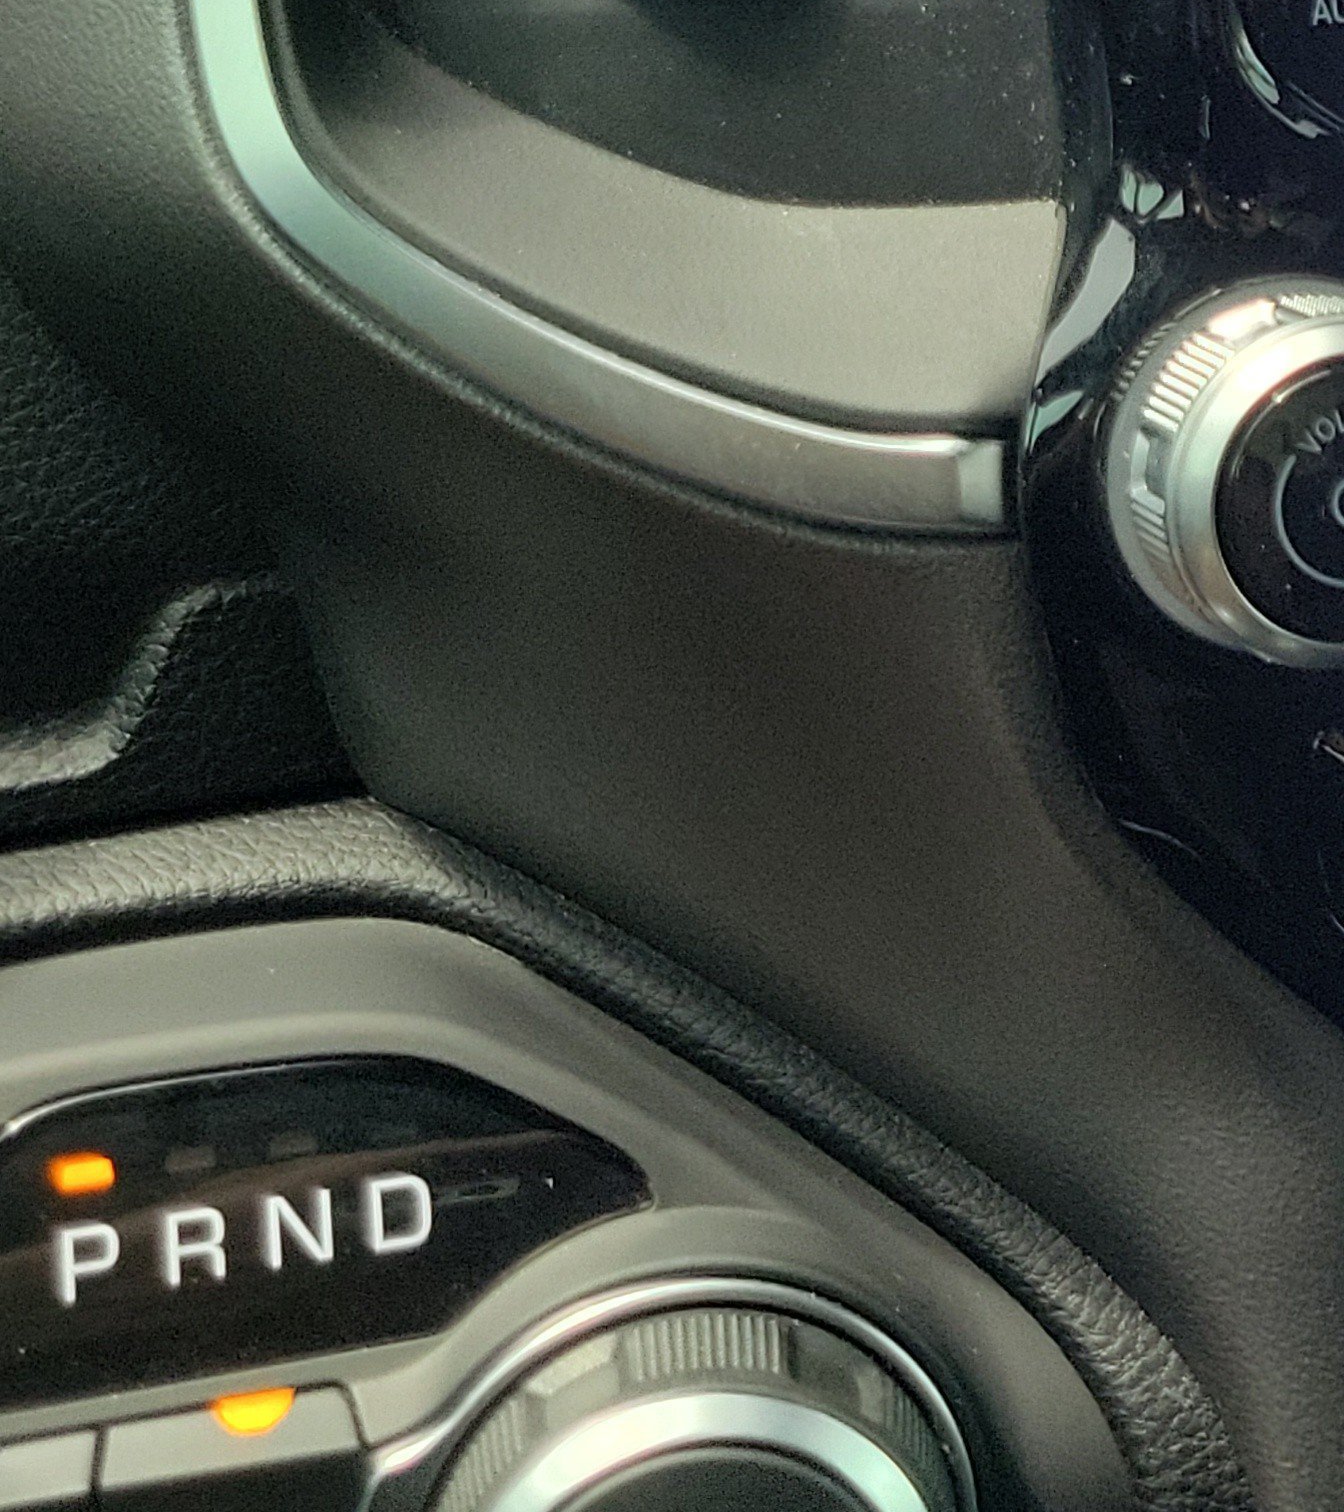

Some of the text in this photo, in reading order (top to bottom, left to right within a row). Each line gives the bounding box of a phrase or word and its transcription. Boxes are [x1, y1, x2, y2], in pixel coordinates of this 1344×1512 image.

[58, 1173, 433, 1306] P R N D
